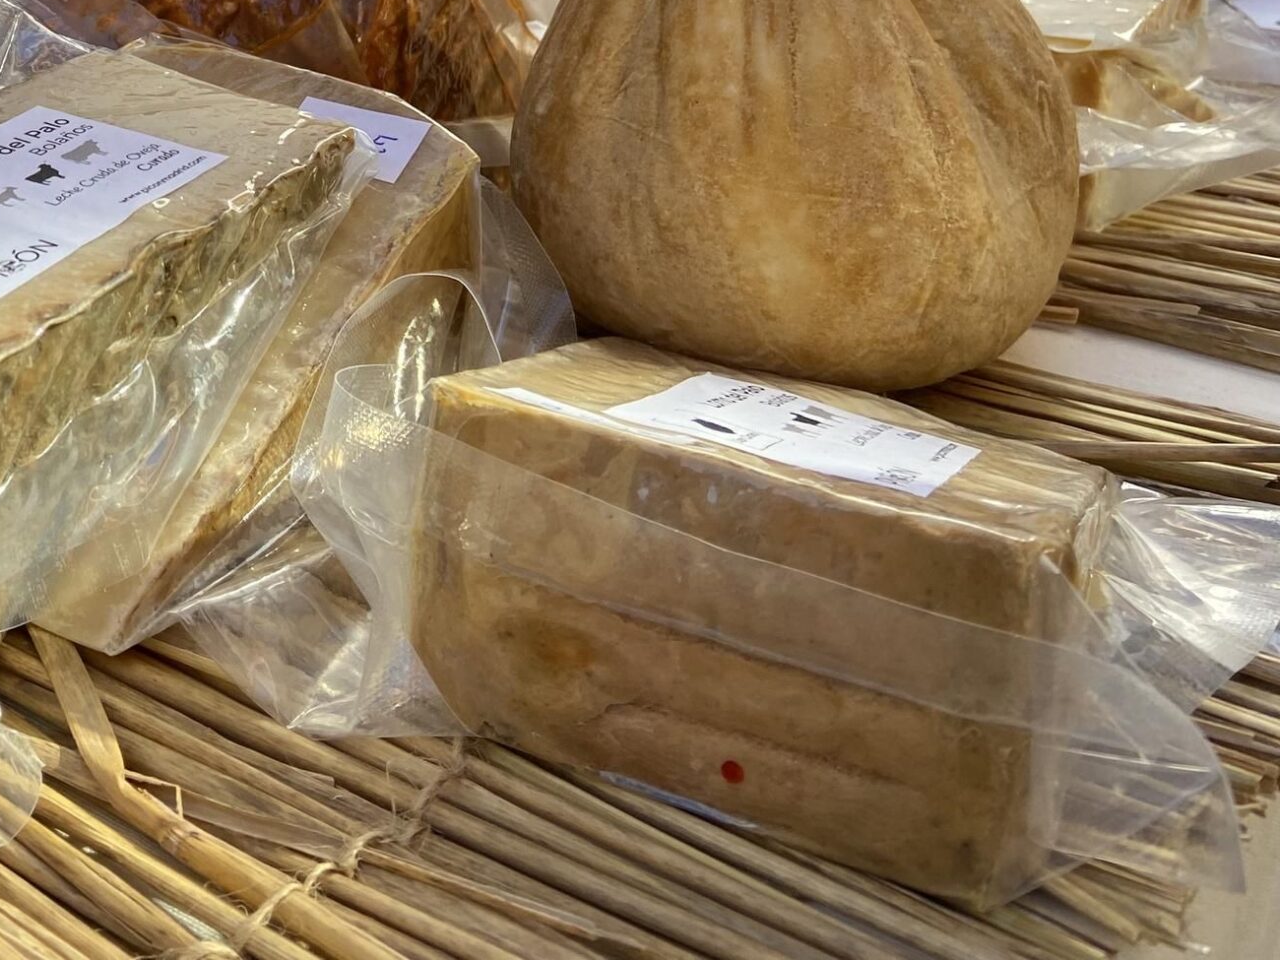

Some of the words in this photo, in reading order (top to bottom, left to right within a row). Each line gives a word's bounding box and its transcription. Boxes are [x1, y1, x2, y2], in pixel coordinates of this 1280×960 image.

[25, 117, 71, 141] Palo
[28, 122, 94, 157] Bolaños
[43, 182, 84, 208] Leche
[81, 165, 114, 189] Cruda
[112, 155, 131, 171] de
[126, 141, 163, 166] Oveja
[136, 147, 181, 174] Curado
